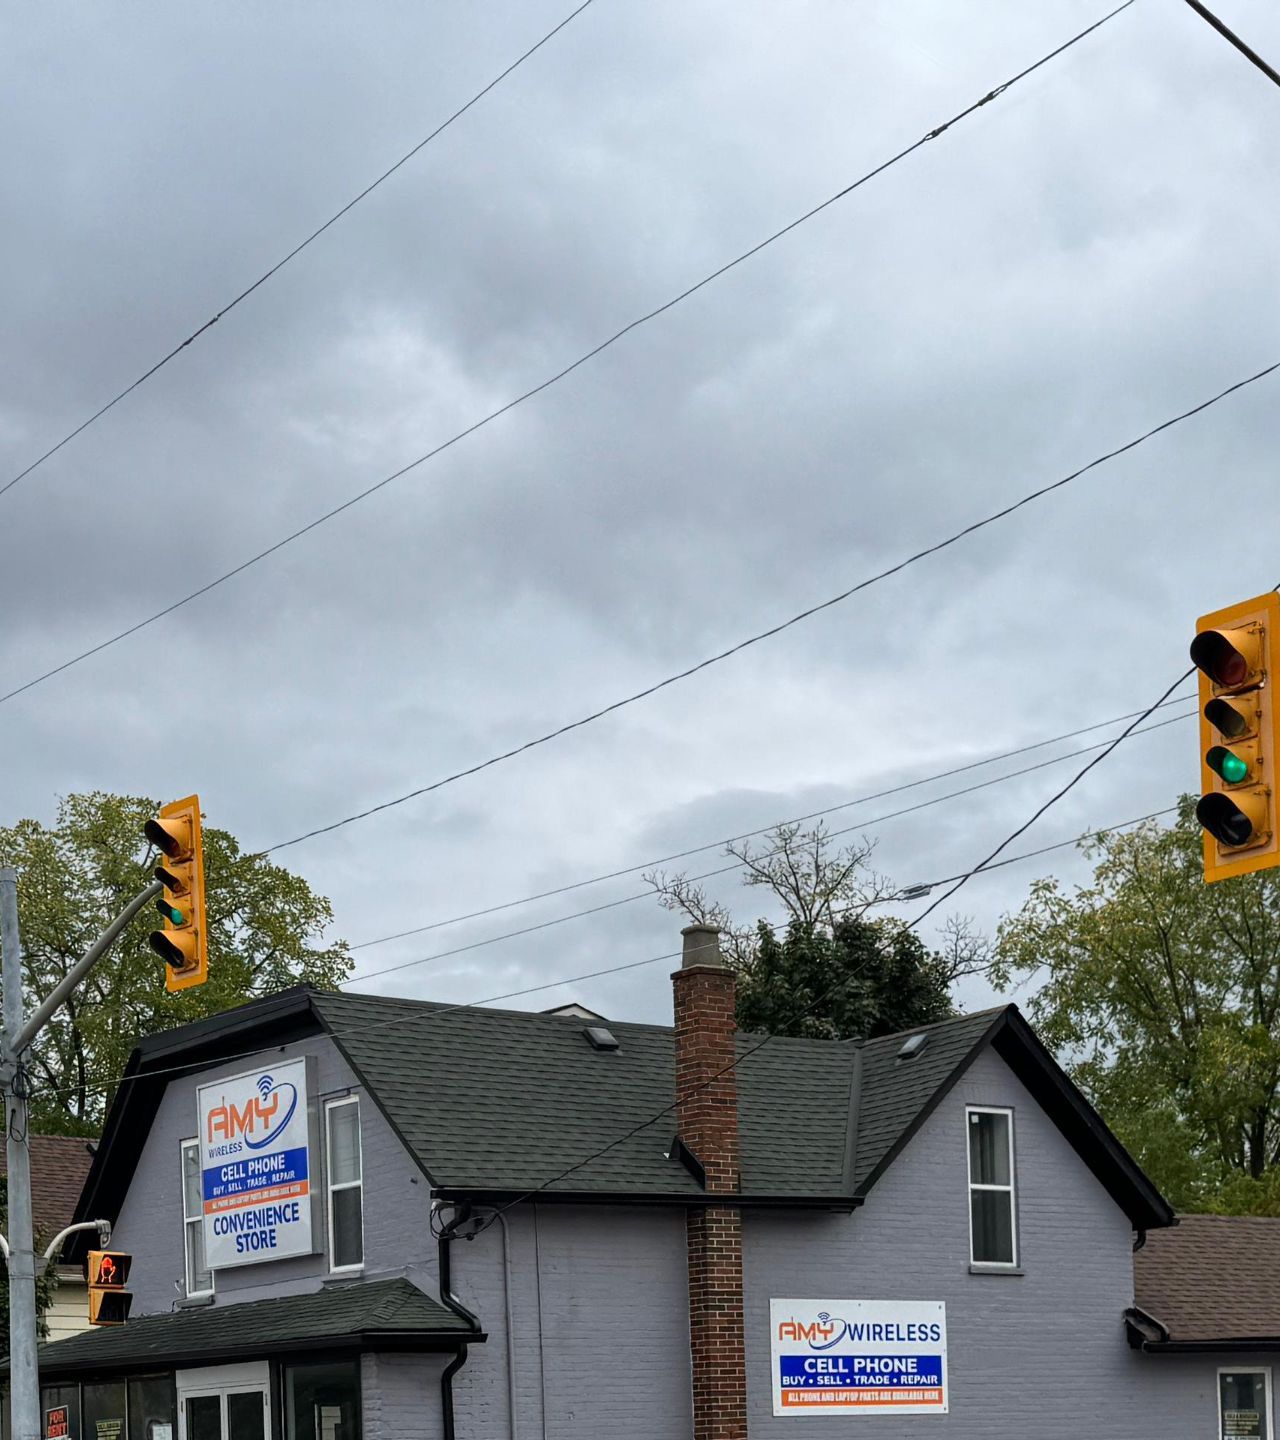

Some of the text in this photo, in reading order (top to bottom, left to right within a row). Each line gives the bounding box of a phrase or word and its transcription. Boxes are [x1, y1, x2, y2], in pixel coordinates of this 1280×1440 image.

[208, 1092, 279, 1143] AMY
[208, 1141, 243, 1159] WIRELESS
[221, 1154, 285, 1182] CELL PHONE
[213, 1170, 296, 1196] BUY SELL TRADE REPAIR
[213, 1202, 300, 1236] CONVENIENCE
[236, 1229, 277, 1253] STORE
[778, 1320, 941, 1342] AMY WIRELESS
[803, 1358, 918, 1373] CELL PHONE
[782, 1375, 938, 1385] BUY SELL TRADE REPAIR
[49, 1410, 64, 1423] FOR
[48, 1423, 67, 1438] RENT
